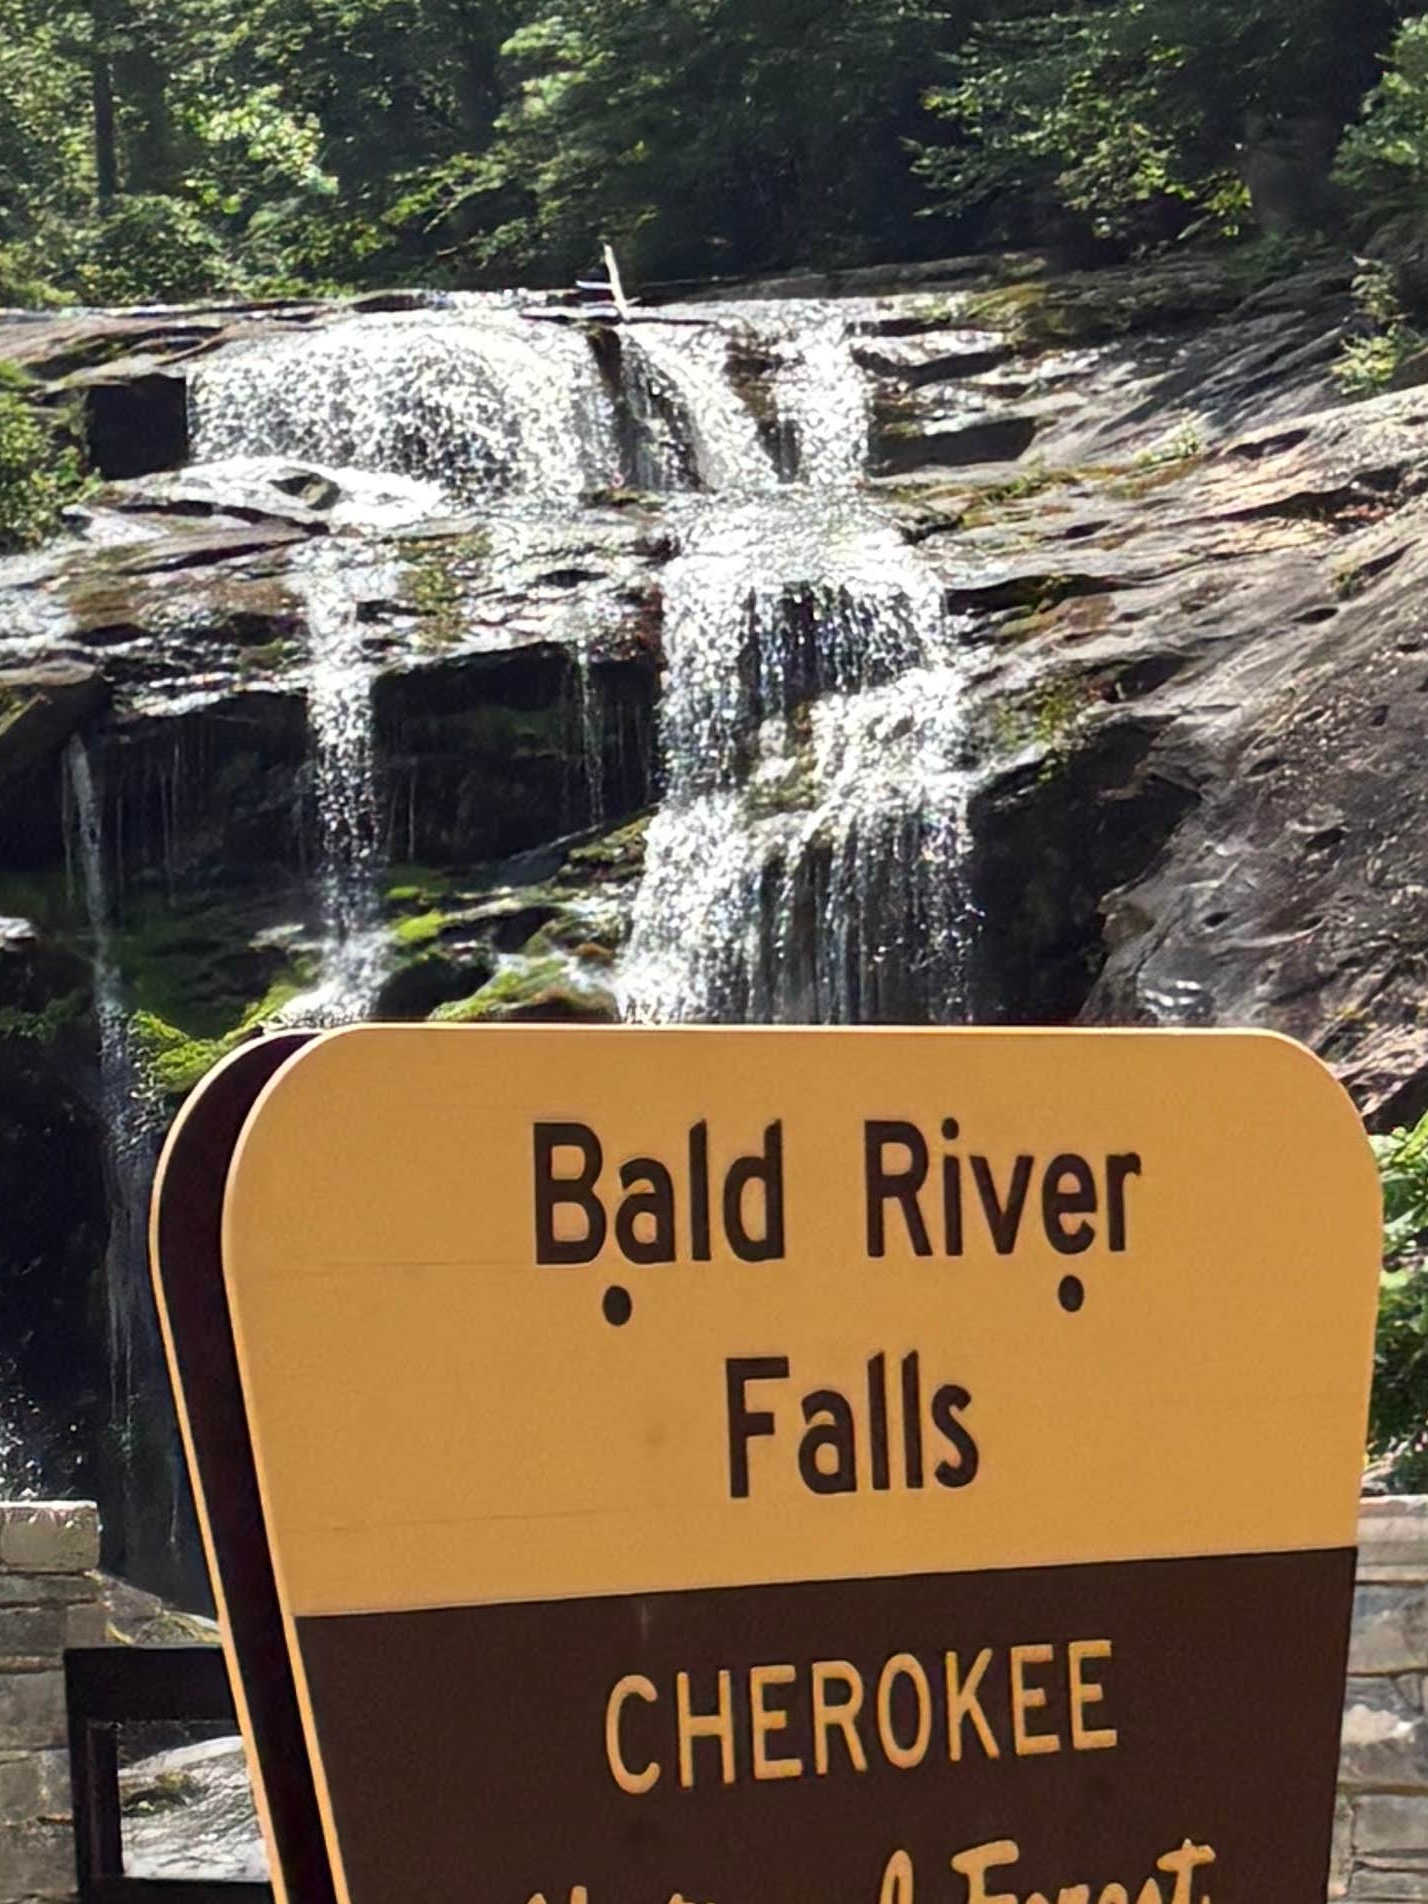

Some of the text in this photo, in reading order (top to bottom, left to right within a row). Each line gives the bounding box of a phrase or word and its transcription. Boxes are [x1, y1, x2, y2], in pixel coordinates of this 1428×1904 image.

[534, 1118, 1141, 1265] Bald River
[726, 1350, 979, 1498] Falls
[606, 1640, 1117, 1793] CHEROKEE
